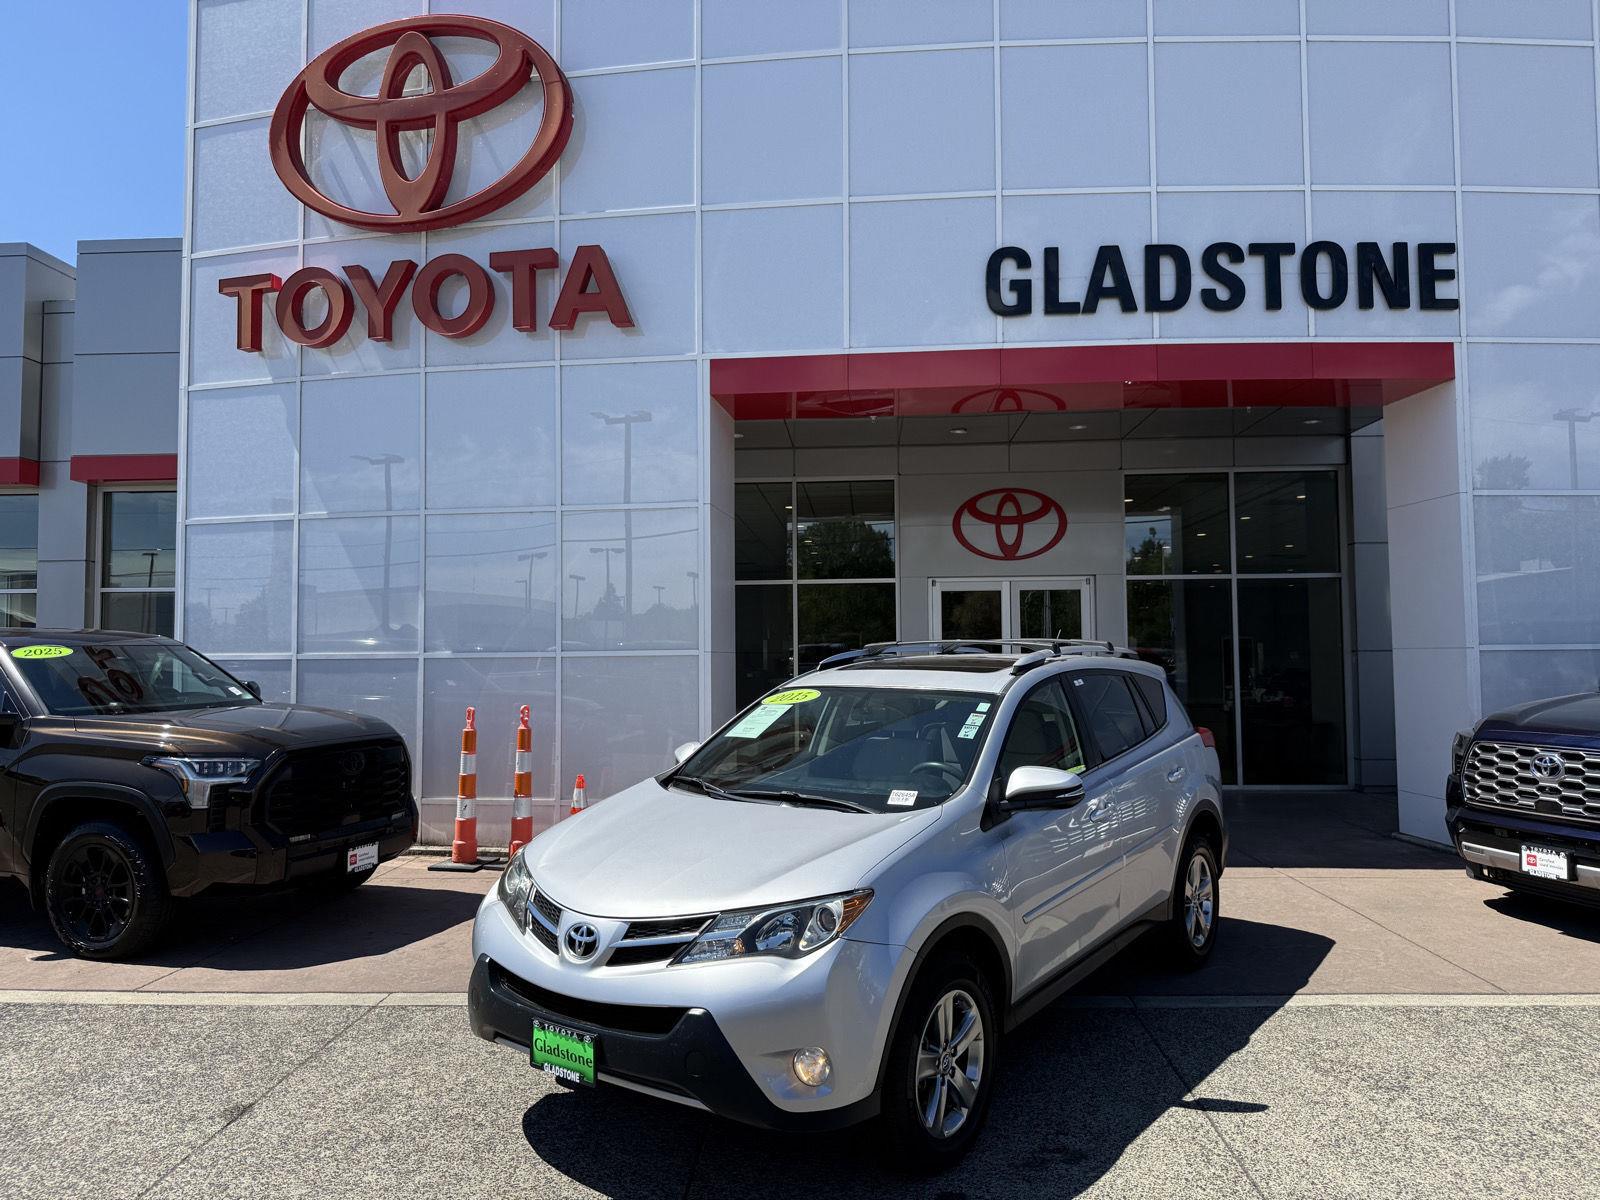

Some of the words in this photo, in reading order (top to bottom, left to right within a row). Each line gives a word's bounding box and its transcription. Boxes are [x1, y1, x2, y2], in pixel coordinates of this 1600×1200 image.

[985, 240, 1460, 317] GLADSTONE
[218, 245, 635, 354] TOYOTA
[23, 647, 63, 657] 2025
[1530, 846, 1556, 855] TOYOTA
[544, 1023, 578, 1039] TOYOTA
[534, 1037, 593, 1069] Gladstone
[543, 1062, 580, 1083] GLADSTONE
